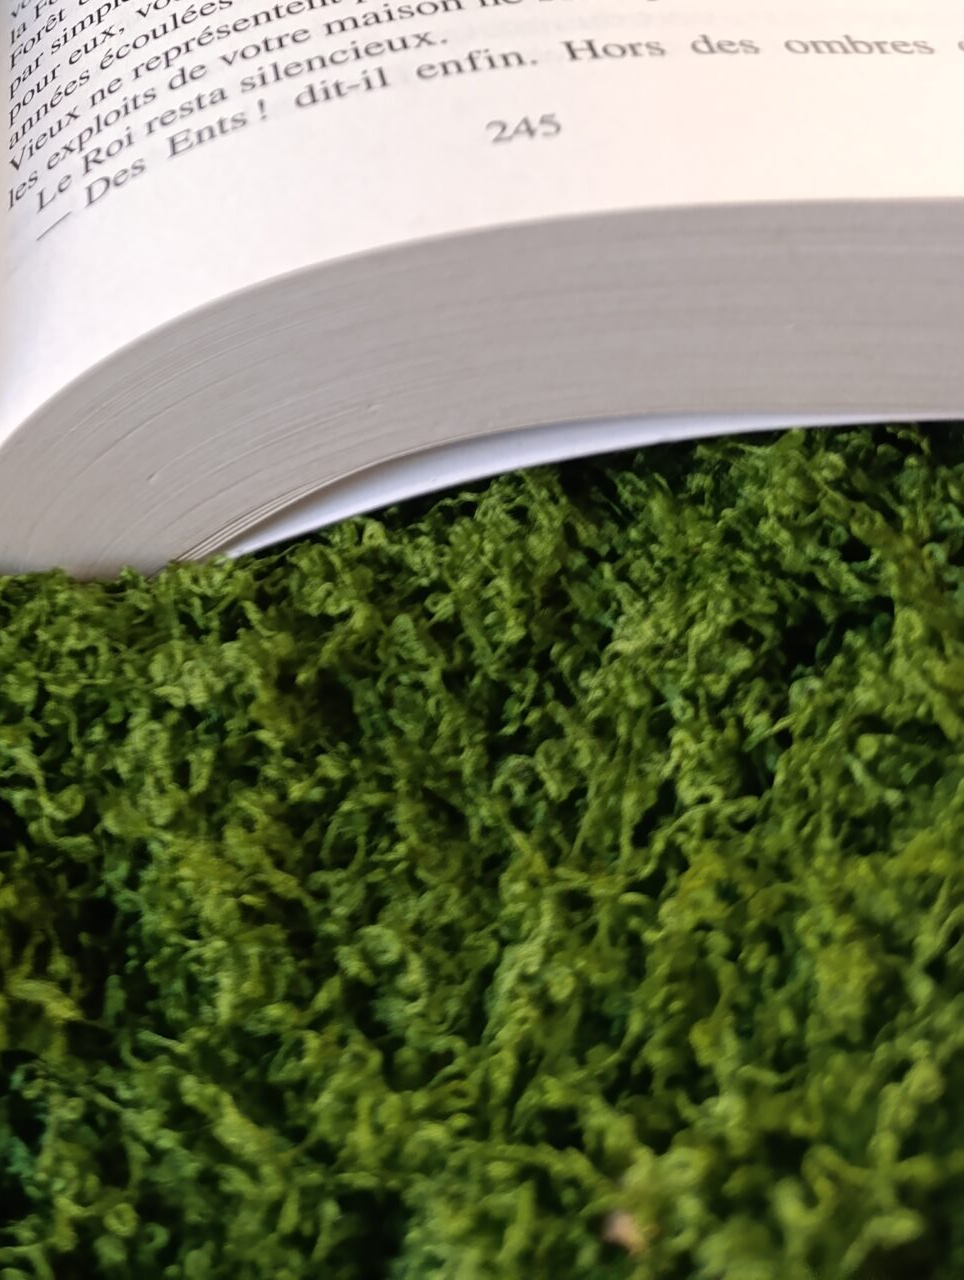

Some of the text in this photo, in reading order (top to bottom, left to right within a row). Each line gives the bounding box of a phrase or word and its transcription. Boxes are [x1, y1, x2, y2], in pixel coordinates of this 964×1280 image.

[9, 53, 44, 100] par
[9, 63, 61, 128] pour
[68, 25, 125, 65] eux,
[10, 21, 27, 45] la
[10, 7, 66, 69] Forêt
[8, 68, 91, 151] années
[8, 170, 38, 211] les
[46, 86, 157, 170] exploits
[168, 63, 207, 91] de
[218, 24, 311, 67] votre
[9, 104, 81, 171] Vieux
[89, 76, 123, 108] ne
[36, 31, 448, 213] Le Roi resta silencieux.
[85, 159, 146, 208] Des
[294, 67, 391, 108] dit-il
[415, 48, 539, 81] enfin.
[560, 39, 666, 62] Hors
[690, 34, 761, 55] des
[784, 34, 937, 55] ombres
[484, 113, 562, 142] 245
